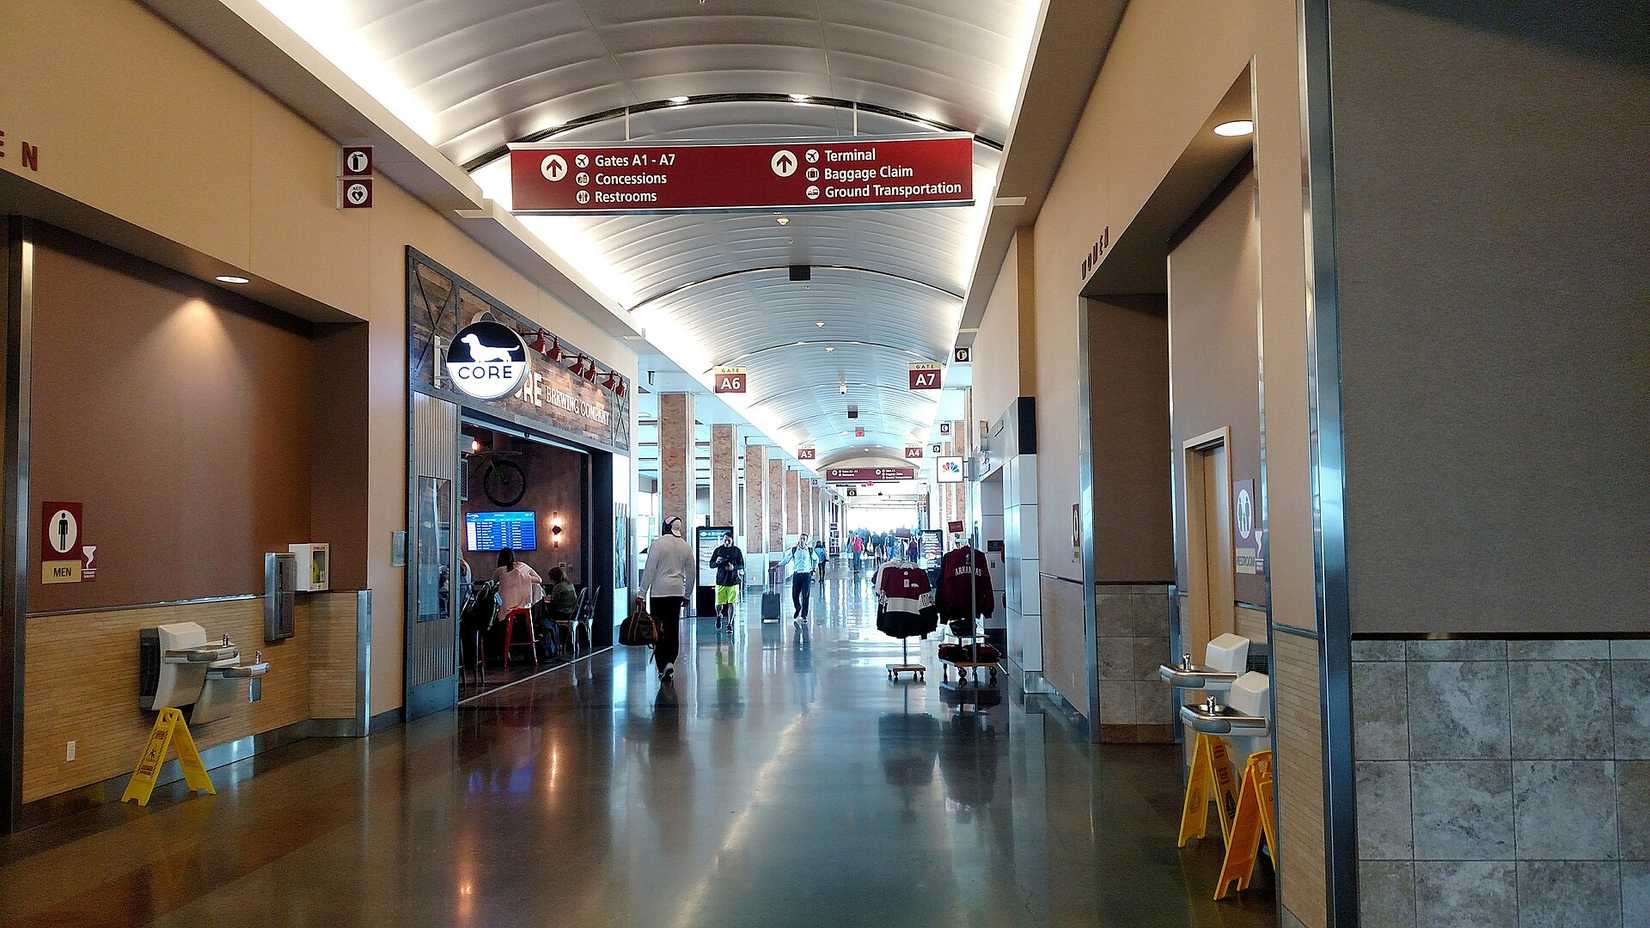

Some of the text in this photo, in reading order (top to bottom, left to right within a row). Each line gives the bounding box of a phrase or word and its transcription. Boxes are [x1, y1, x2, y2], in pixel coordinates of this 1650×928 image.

[595, 154, 629, 167] Gates
[632, 154, 647, 166] A1
[659, 153, 676, 166] A7
[824, 147, 876, 162] Terminal
[595, 172, 667, 185] Concessions
[824, 165, 913, 182] Baggage Claim
[825, 181, 962, 198] Ground Transportation
[595, 190, 657, 203] Restrooms
[458, 365, 513, 379] CORE
[720, 377, 741, 390] A6
[915, 373, 936, 386] A7
[546, 386, 580, 414] BREWING
[800, 450, 813, 458] A5
[908, 448, 920, 457] A4
[53, 567, 72, 577] MEN
